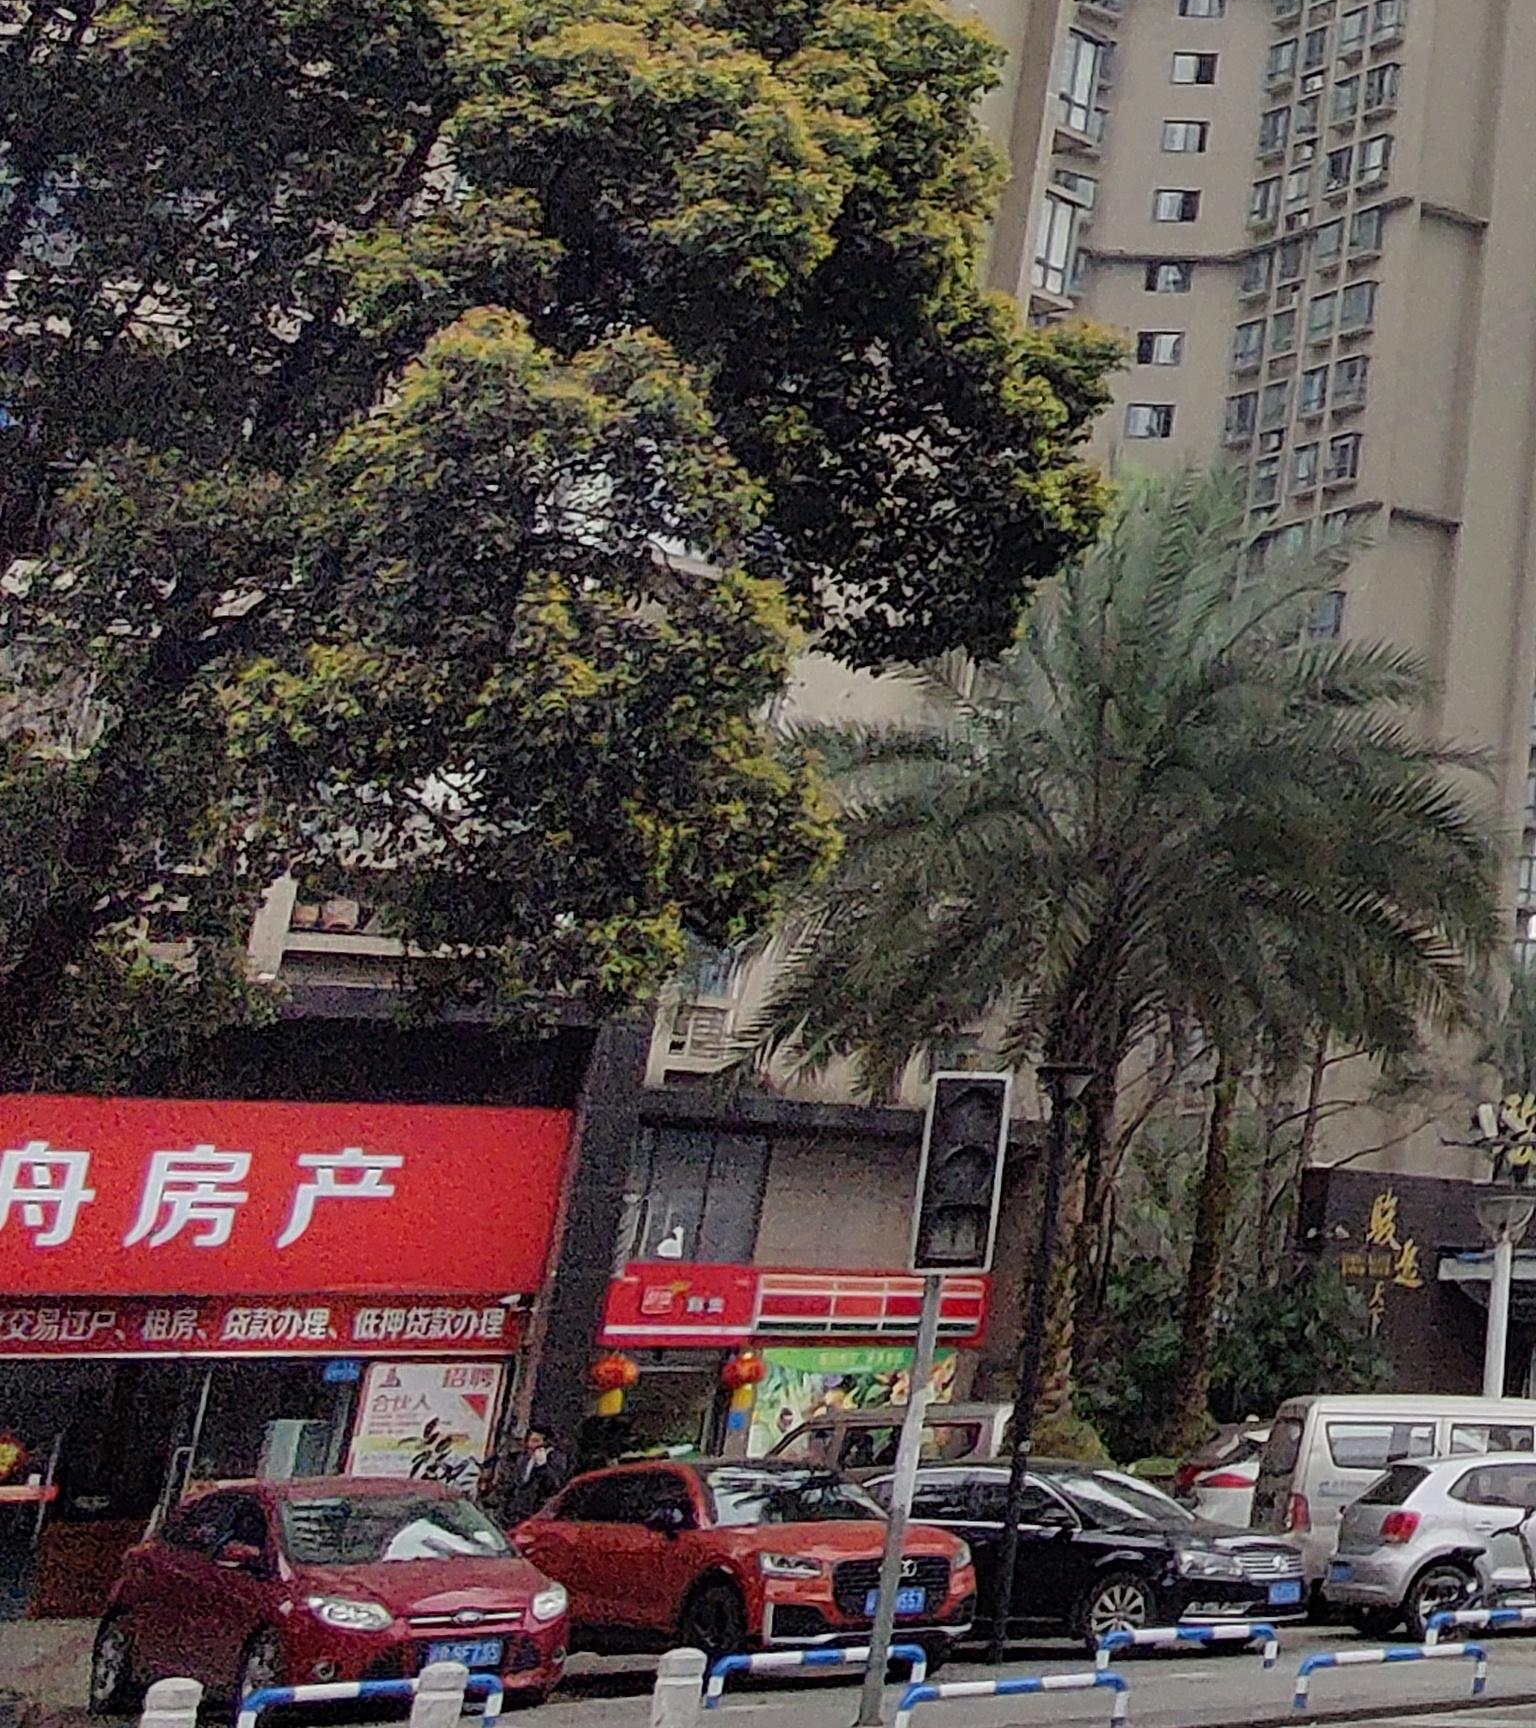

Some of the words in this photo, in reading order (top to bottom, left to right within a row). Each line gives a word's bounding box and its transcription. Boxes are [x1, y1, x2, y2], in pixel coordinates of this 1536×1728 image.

[0, 1140, 403, 1249] 舟房产
[371, 1393, 431, 1412] 合伙人
